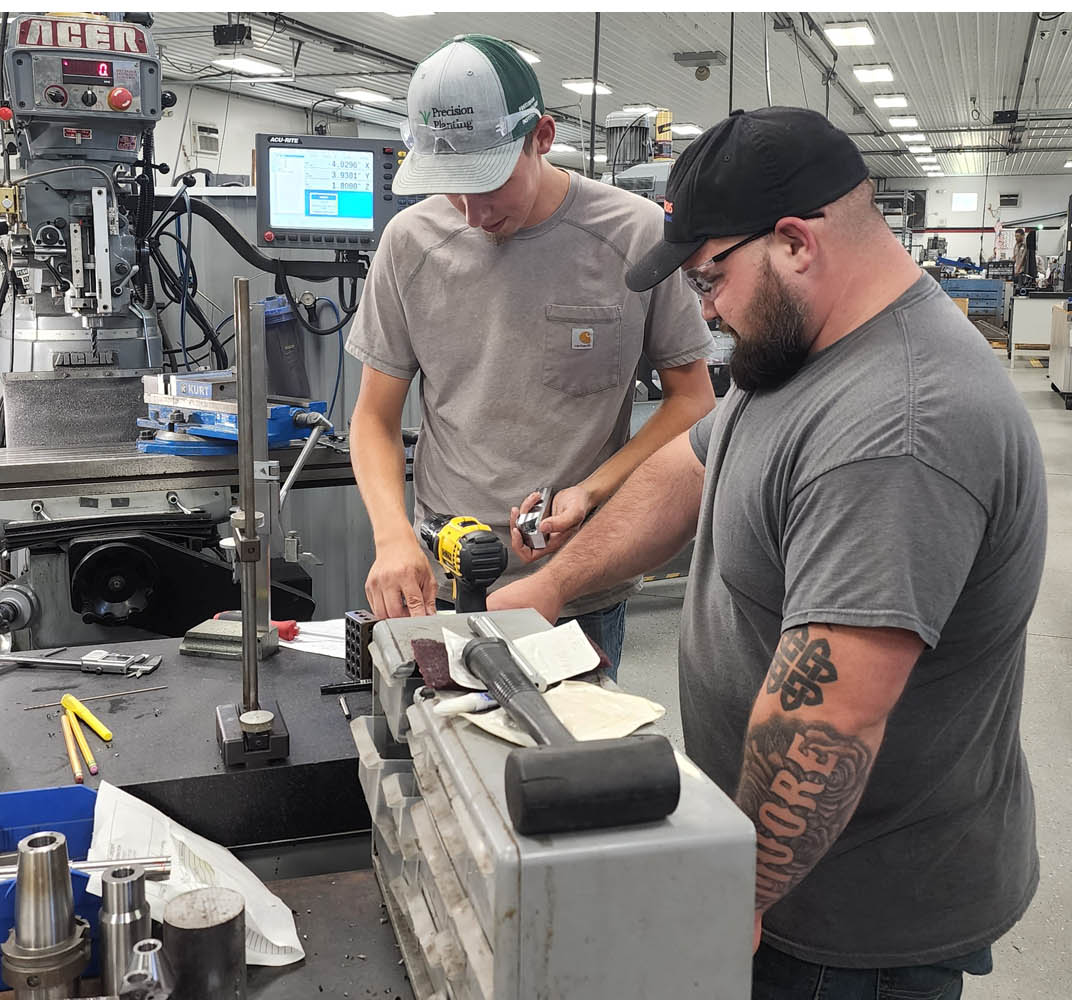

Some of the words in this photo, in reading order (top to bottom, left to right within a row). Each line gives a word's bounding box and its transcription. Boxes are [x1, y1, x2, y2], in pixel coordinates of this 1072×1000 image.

[26, 19, 140, 53] ACER
[432, 105, 474, 118] Precision
[433, 119, 473, 131] Planting
[270, 136, 299, 144] ACU-RITE
[189, 383, 209, 396] KURT
